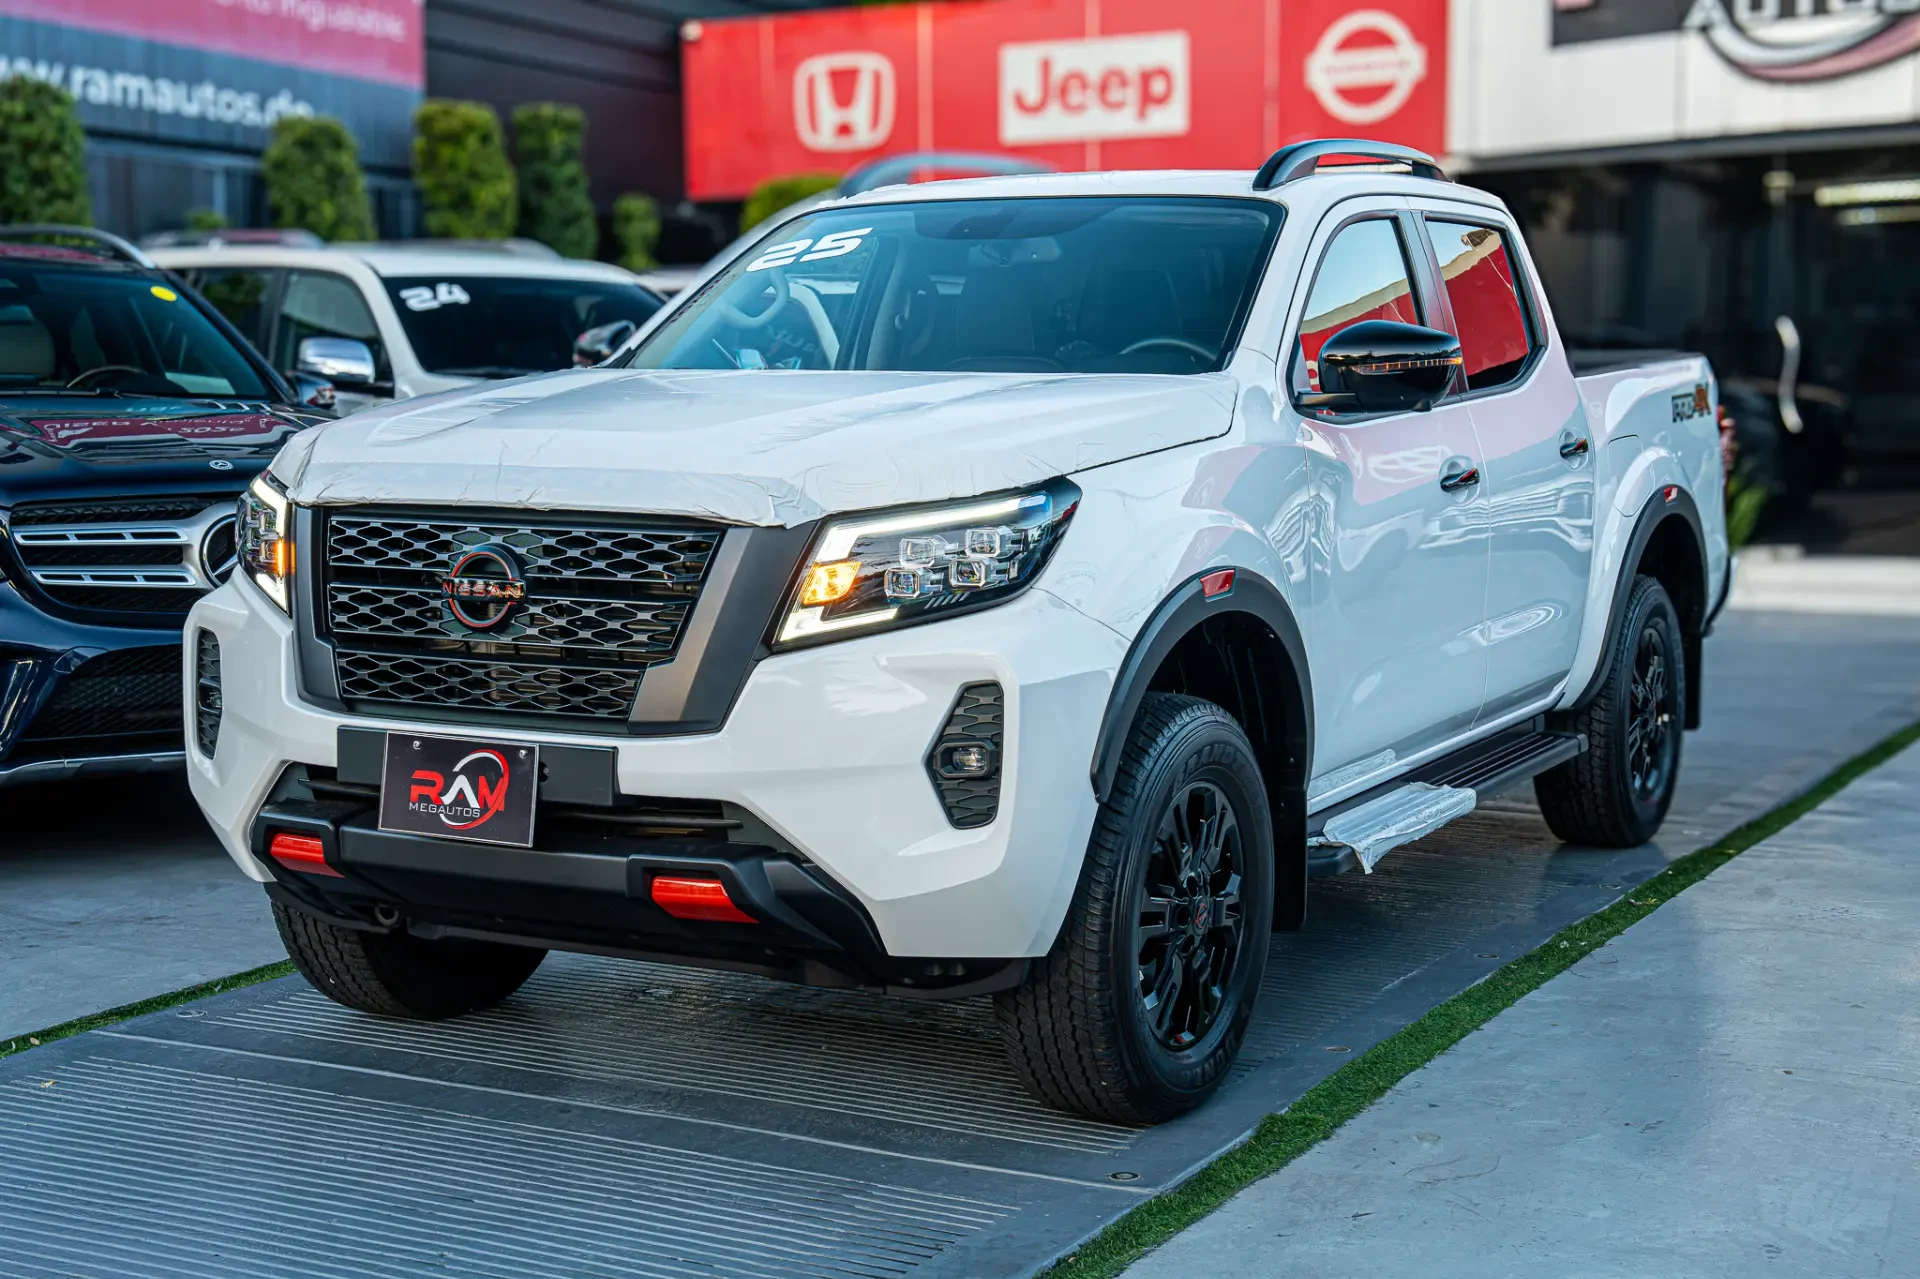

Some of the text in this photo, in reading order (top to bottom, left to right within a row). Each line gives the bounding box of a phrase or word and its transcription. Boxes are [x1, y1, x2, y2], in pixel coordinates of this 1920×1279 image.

[1013, 56, 1174, 121] Jeep
[746, 227, 873, 272] 25
[399, 282, 471, 312] 24
[442, 581, 524, 599] NISSAN
[409, 769, 507, 811] RAM
[409, 802, 481, 818] MEGAUTOS
